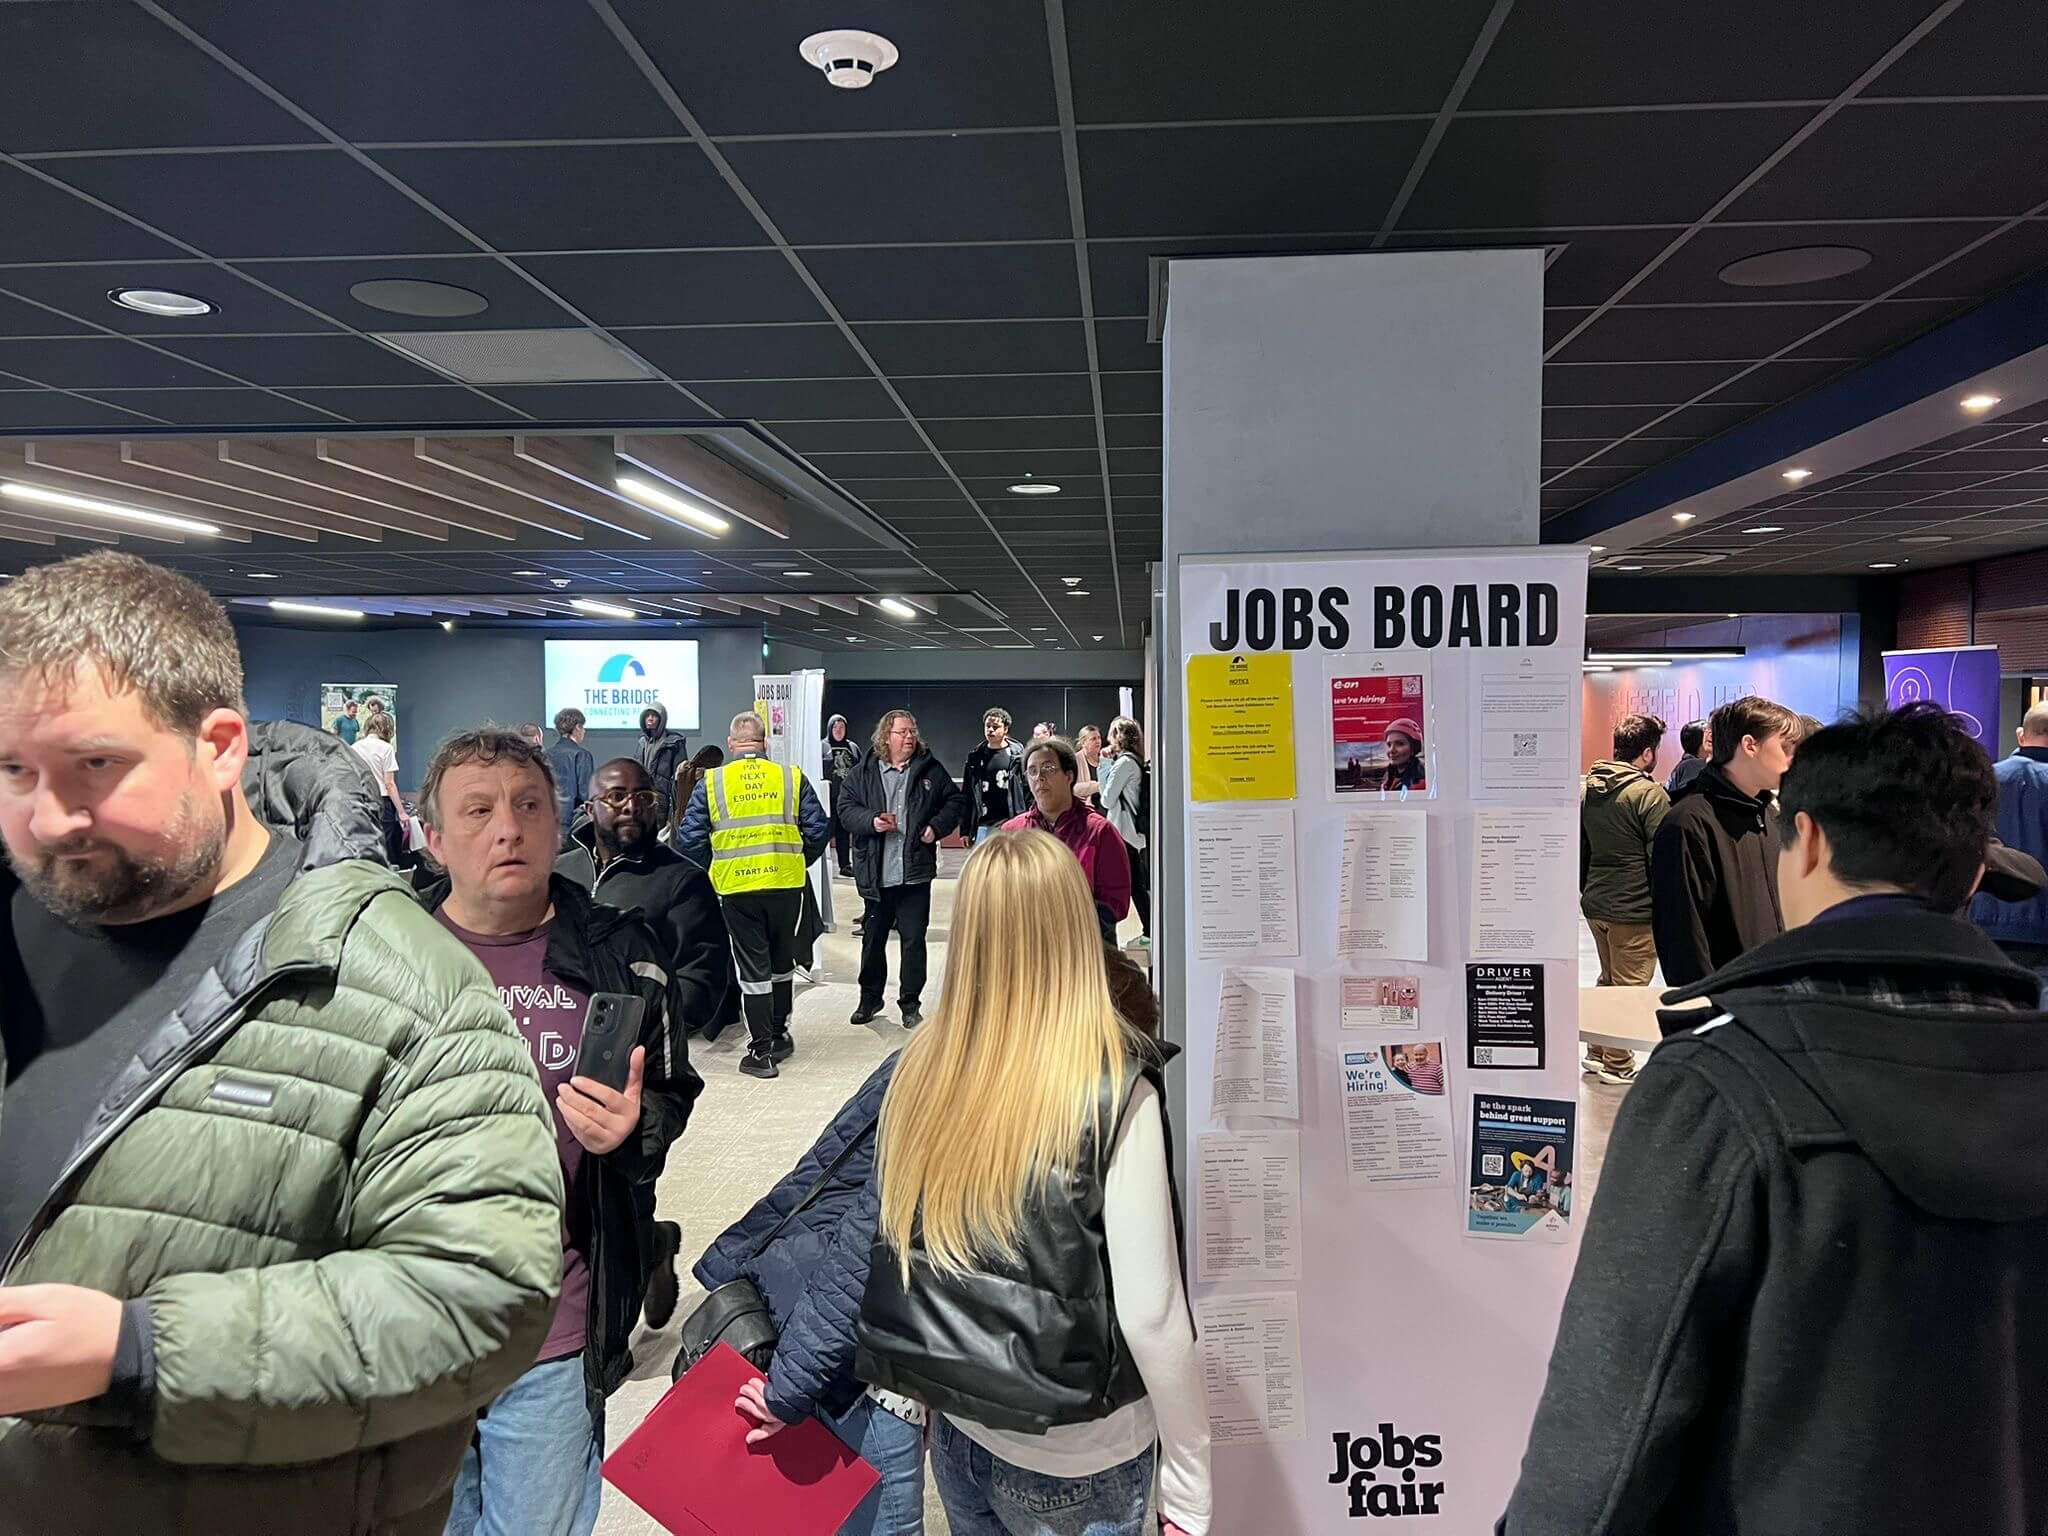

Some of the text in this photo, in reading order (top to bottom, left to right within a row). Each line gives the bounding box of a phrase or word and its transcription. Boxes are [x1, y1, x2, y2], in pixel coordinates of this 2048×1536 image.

[1209, 582, 1559, 652] JOBS BOARD
[584, 689, 659, 704] THE BRIDGE
[757, 684, 775, 700] JOBS
[1333, 694, 1386, 704] we're hiring
[739, 772, 766, 781] NEXT
[733, 791, 778, 803] £900+PW
[735, 867, 761, 877] START
[1476, 967, 1532, 977] DRIVER
[1345, 1070, 1381, 1081] We're
[1347, 1080, 1388, 1093] Hiring!
[1480, 1101, 1532, 1113] Be the spark
[1479, 1110, 1566, 1126] behind great support
[1328, 1422, 1443, 1484] Jobs
[1347, 1467, 1445, 1518] fair
